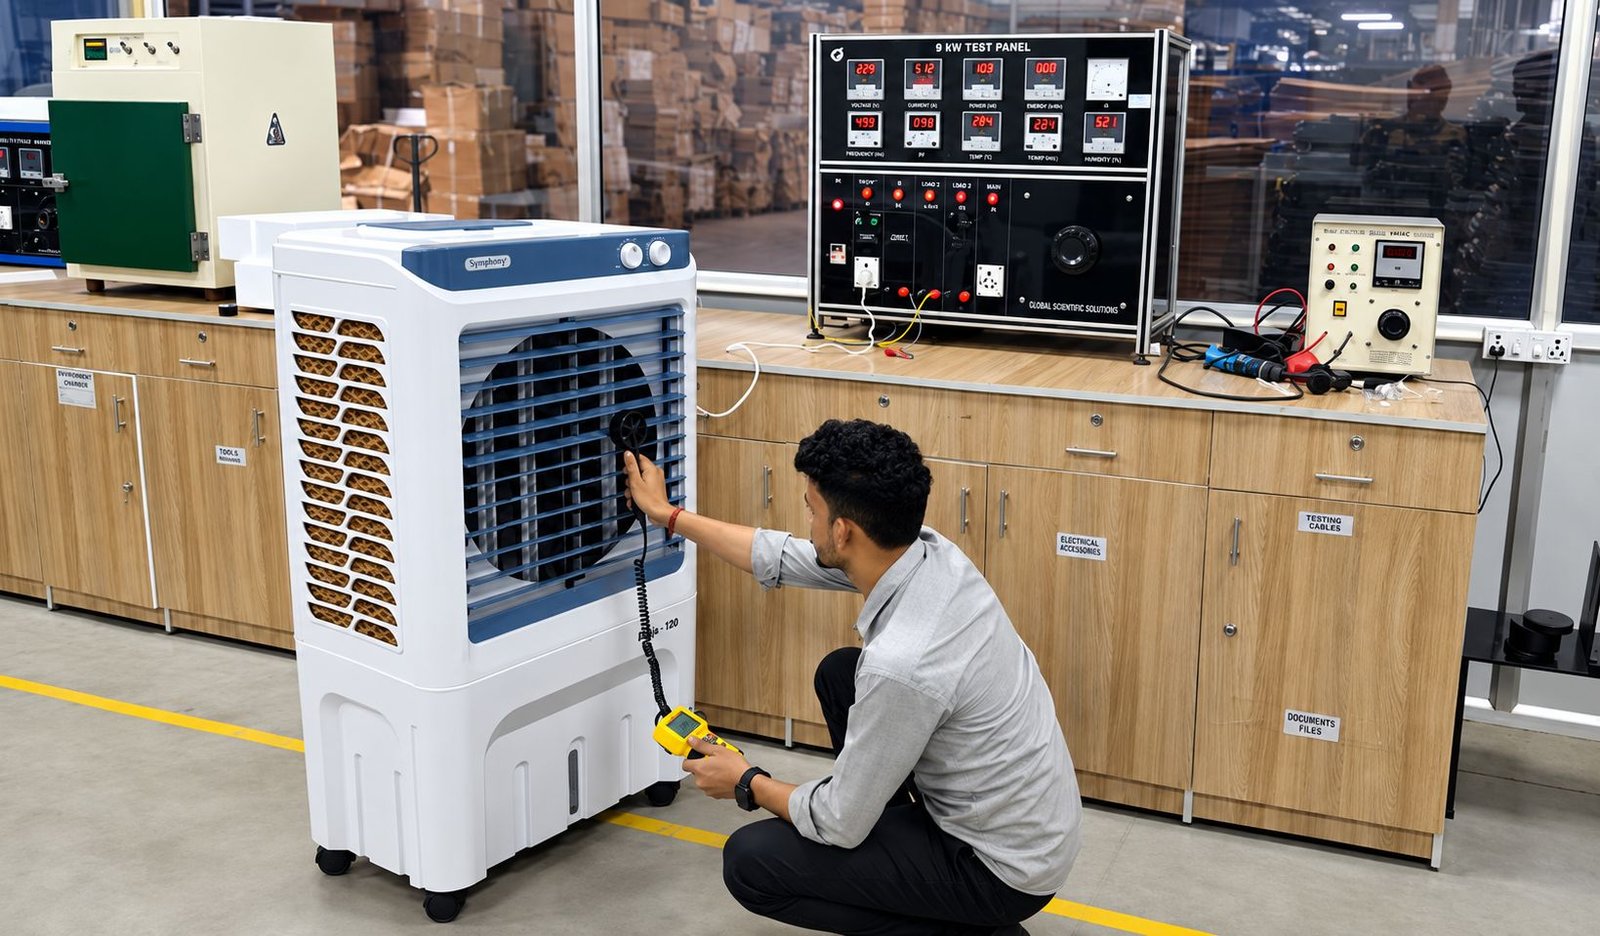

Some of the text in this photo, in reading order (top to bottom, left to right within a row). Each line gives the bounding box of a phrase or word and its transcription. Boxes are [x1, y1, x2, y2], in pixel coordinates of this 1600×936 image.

[935, 43, 942, 52] 9
[965, 42, 993, 52] TEST
[995, 42, 1031, 52] PANEL
[856, 63, 876, 75] 229
[976, 63, 994, 74] 103
[1035, 62, 1057, 74] 000
[855, 117, 875, 128] 499
[913, 117, 934, 128] 098
[972, 115, 993, 127] 284
[470, 257, 507, 269] Symphony
[1029, 301, 1119, 314] GLOBAL SCIENTIFIC SOLUTIONS
[219, 448, 239, 456] TOOLS
[1306, 514, 1342, 524] TESTING
[1309, 522, 1341, 532] CABLES
[1060, 535, 1099, 547] ELECTRICAL
[1060, 544, 1101, 556] ACCESSORIES
[665, 617, 679, 631] 120
[1287, 712, 1336, 728] DOCUMENTS
[1298, 724, 1322, 736] FILES
